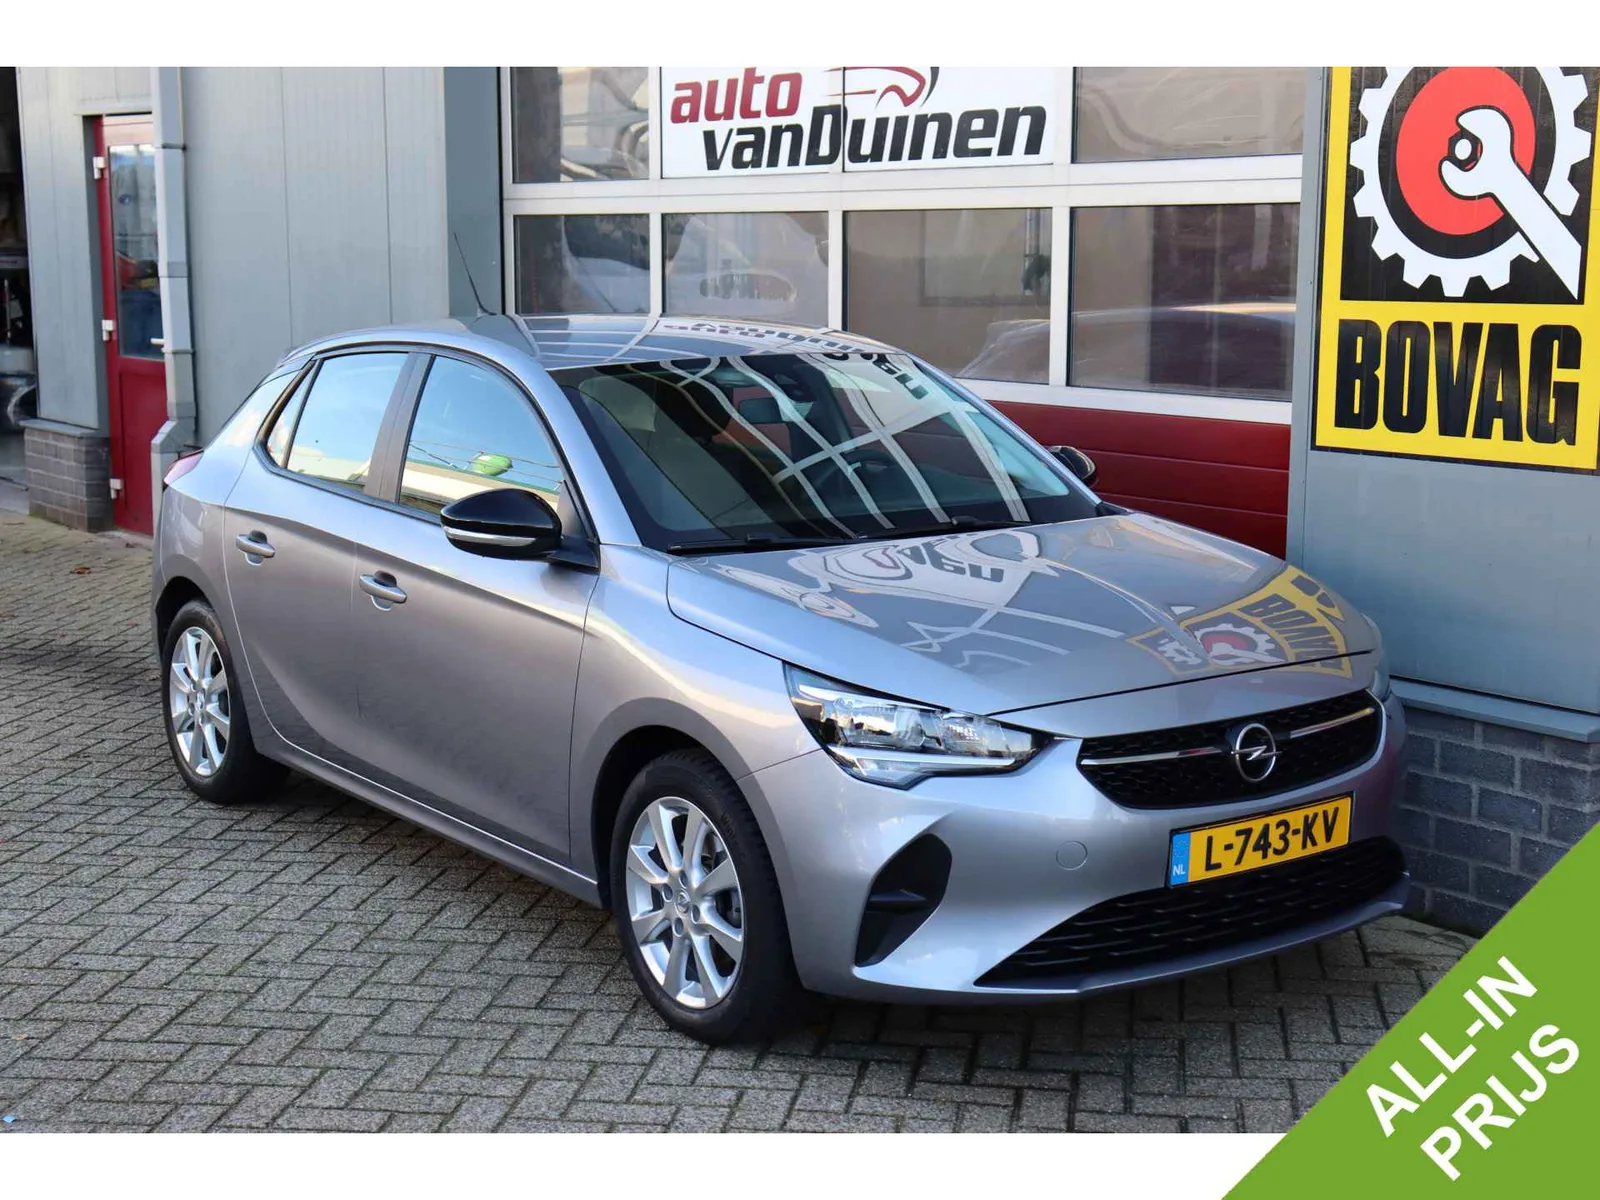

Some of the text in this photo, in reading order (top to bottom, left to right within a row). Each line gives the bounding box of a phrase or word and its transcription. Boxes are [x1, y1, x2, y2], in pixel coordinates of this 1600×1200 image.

[671, 67, 802, 123] auto
[702, 105, 1047, 171] vanDuinen
[1334, 318, 1582, 446] BOVAG
[1172, 864, 1186, 876] NL
[1204, 806, 1340, 872] L-743-KV
